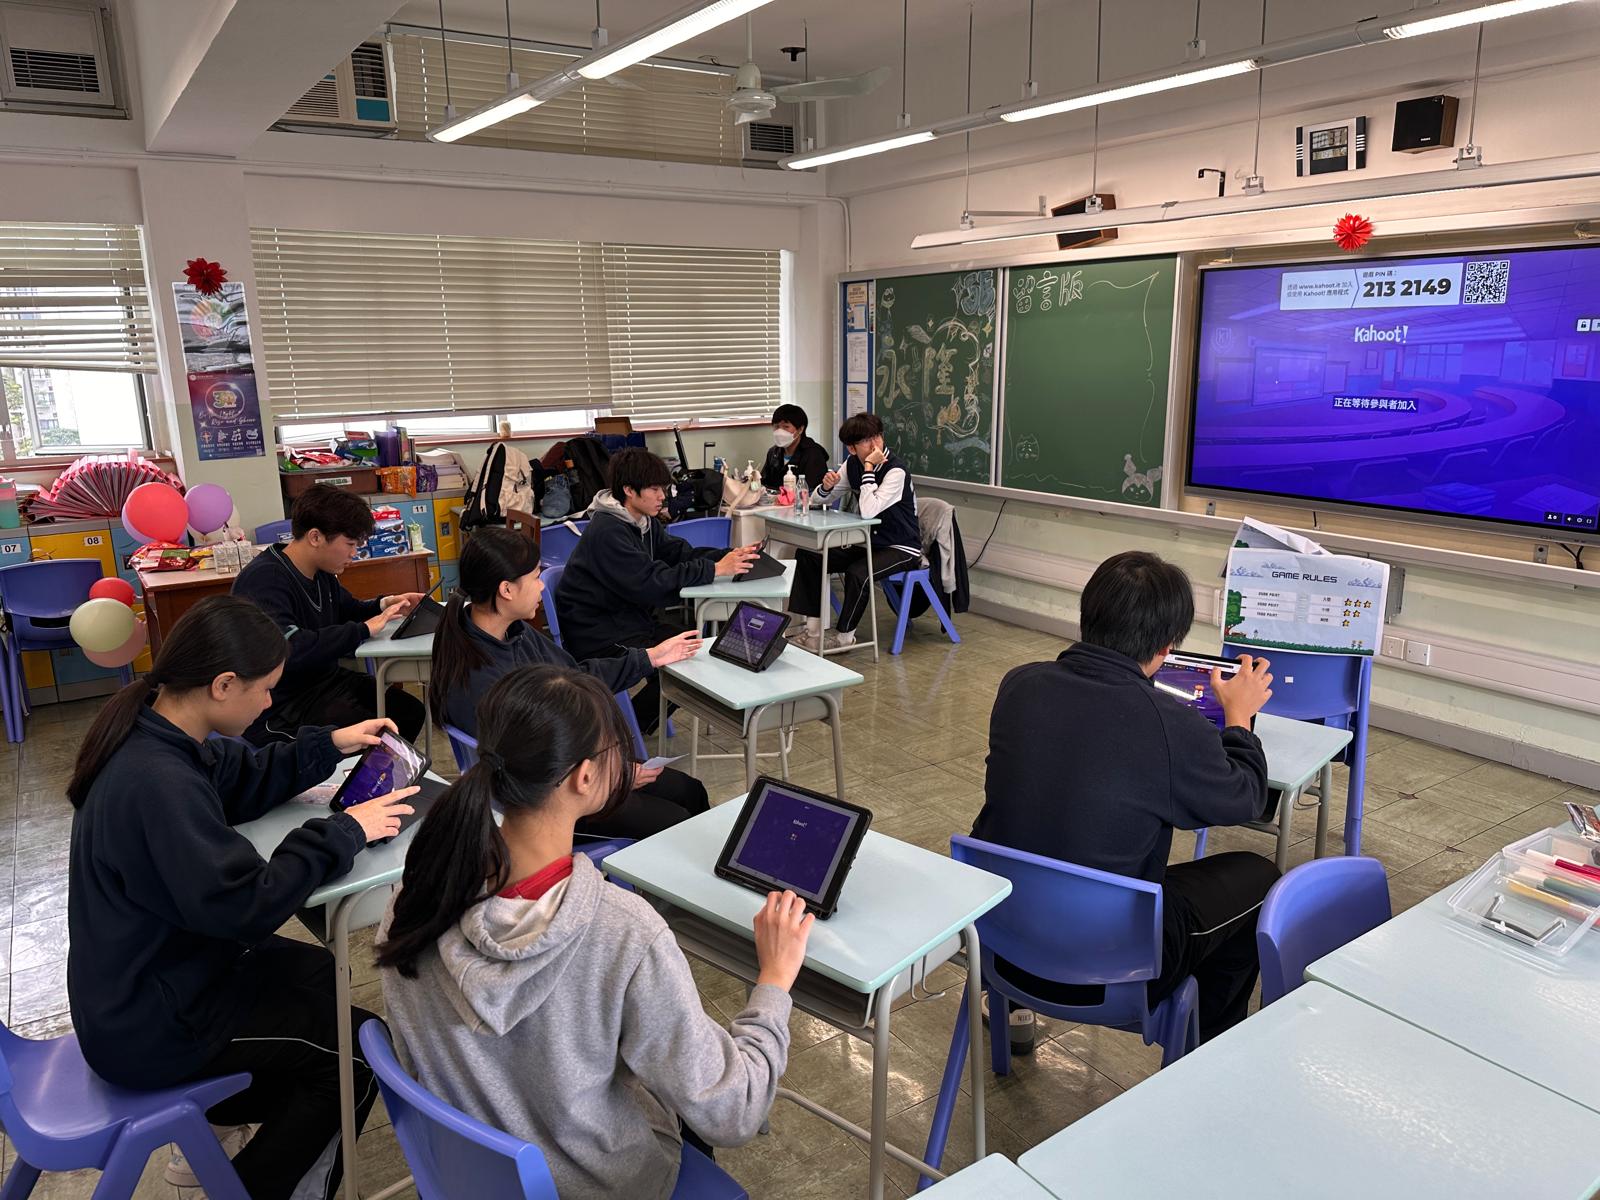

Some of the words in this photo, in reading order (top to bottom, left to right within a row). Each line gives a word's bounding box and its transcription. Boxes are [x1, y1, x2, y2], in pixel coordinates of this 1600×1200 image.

[1363, 281, 1396, 298] 213
[1400, 278, 1452, 297] 2149
[1354, 324, 1409, 344] Kahoot!
[1334, 397, 1417, 411] 正在等待參與者加入
[87, 537, 100, 545] 08
[4, 545, 17, 553] 07
[1271, 571, 1300, 580] GAME
[1302, 573, 1338, 583] RULES
